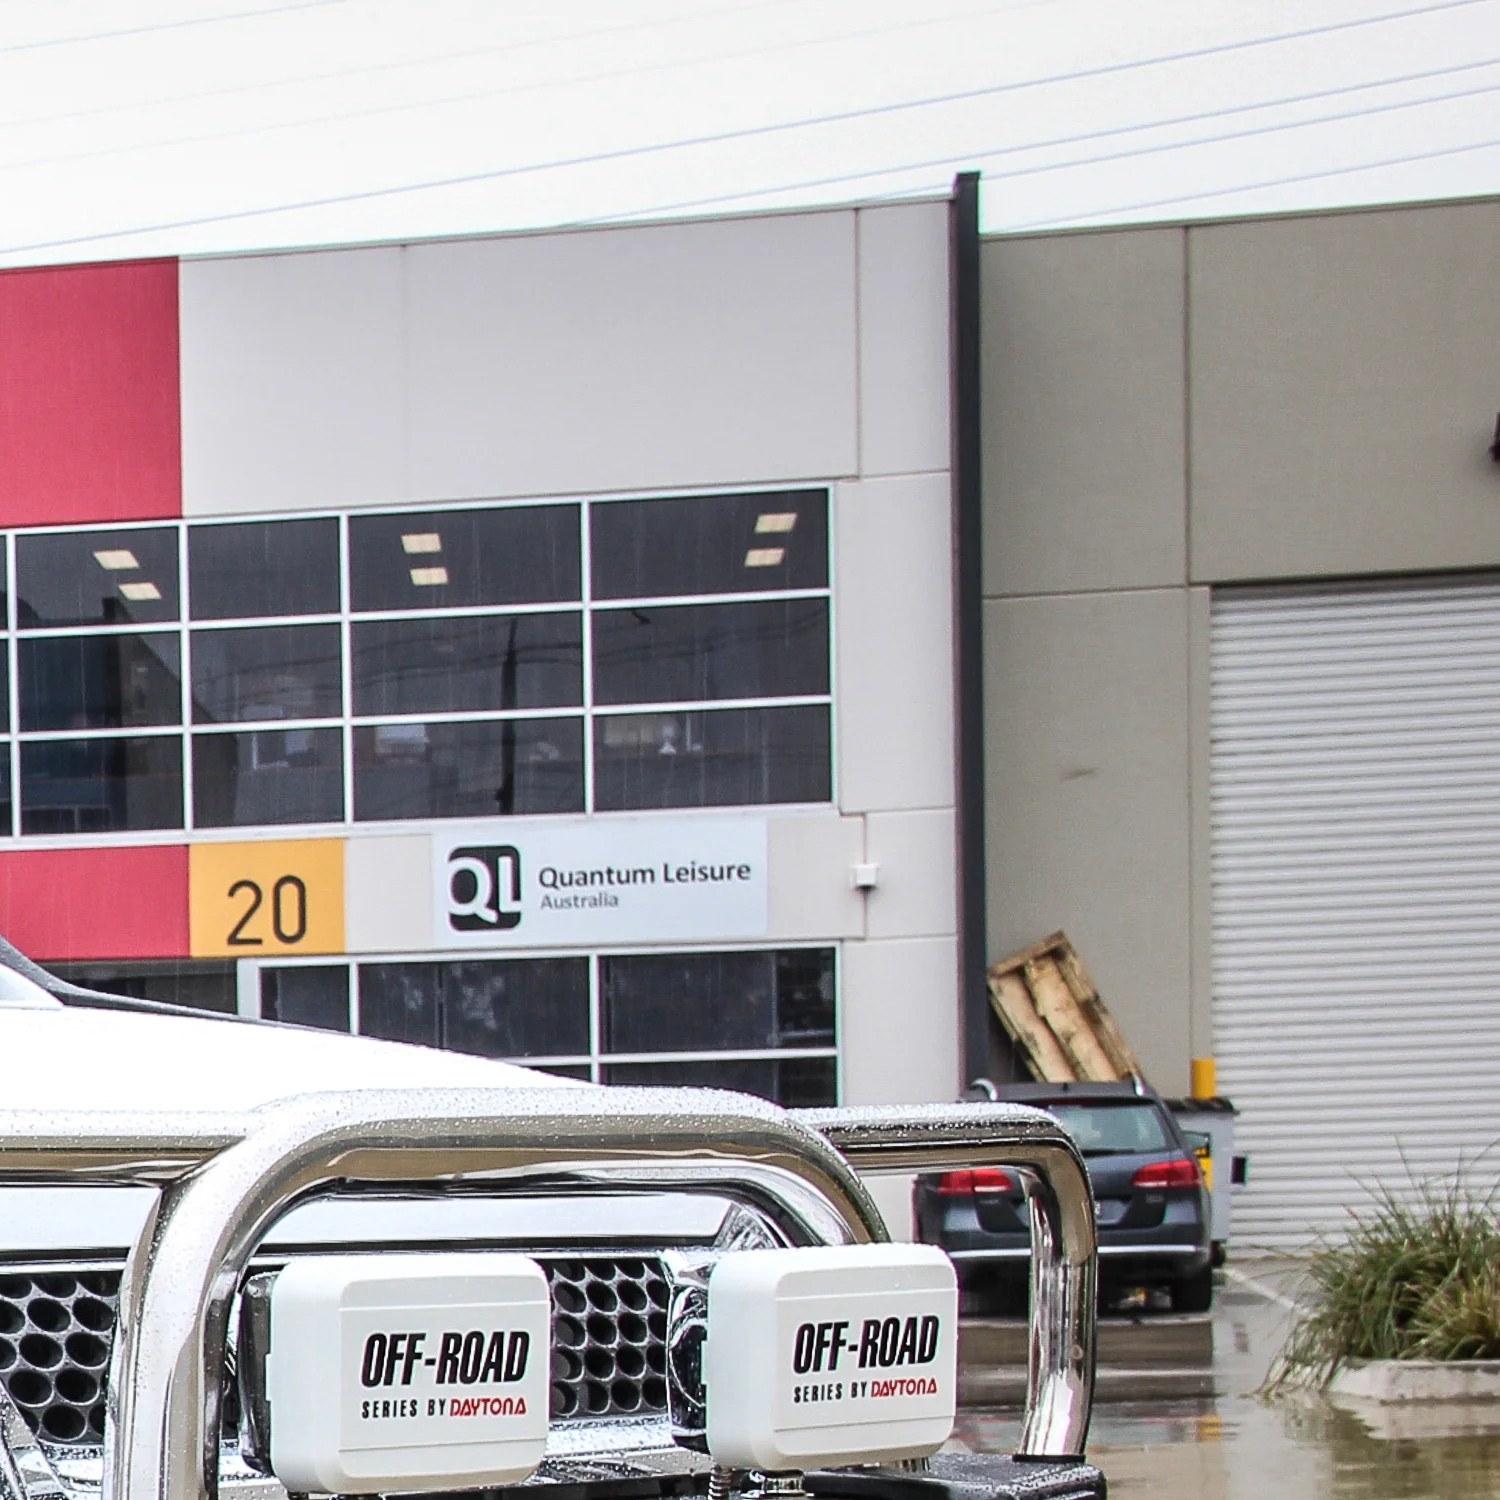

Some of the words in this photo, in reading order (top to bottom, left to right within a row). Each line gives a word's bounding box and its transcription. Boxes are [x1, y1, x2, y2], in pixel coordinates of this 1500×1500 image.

[447, 846, 523, 930] QL
[538, 863, 655, 889] Quantum
[663, 860, 751, 884] Leisure
[226, 874, 307, 945] 20
[539, 892, 620, 909] Australia
[361, 1330, 531, 1388] OFF-ROAD
[792, 1315, 939, 1375] OFF-ROAD
[361, 1398, 419, 1420] SERIES
[427, 1397, 447, 1417] BY
[449, 1396, 527, 1417] DAYTONA
[793, 1381, 843, 1403] SERIES
[851, 1380, 868, 1399] BY
[870, 1376, 938, 1398] DAYTONA
